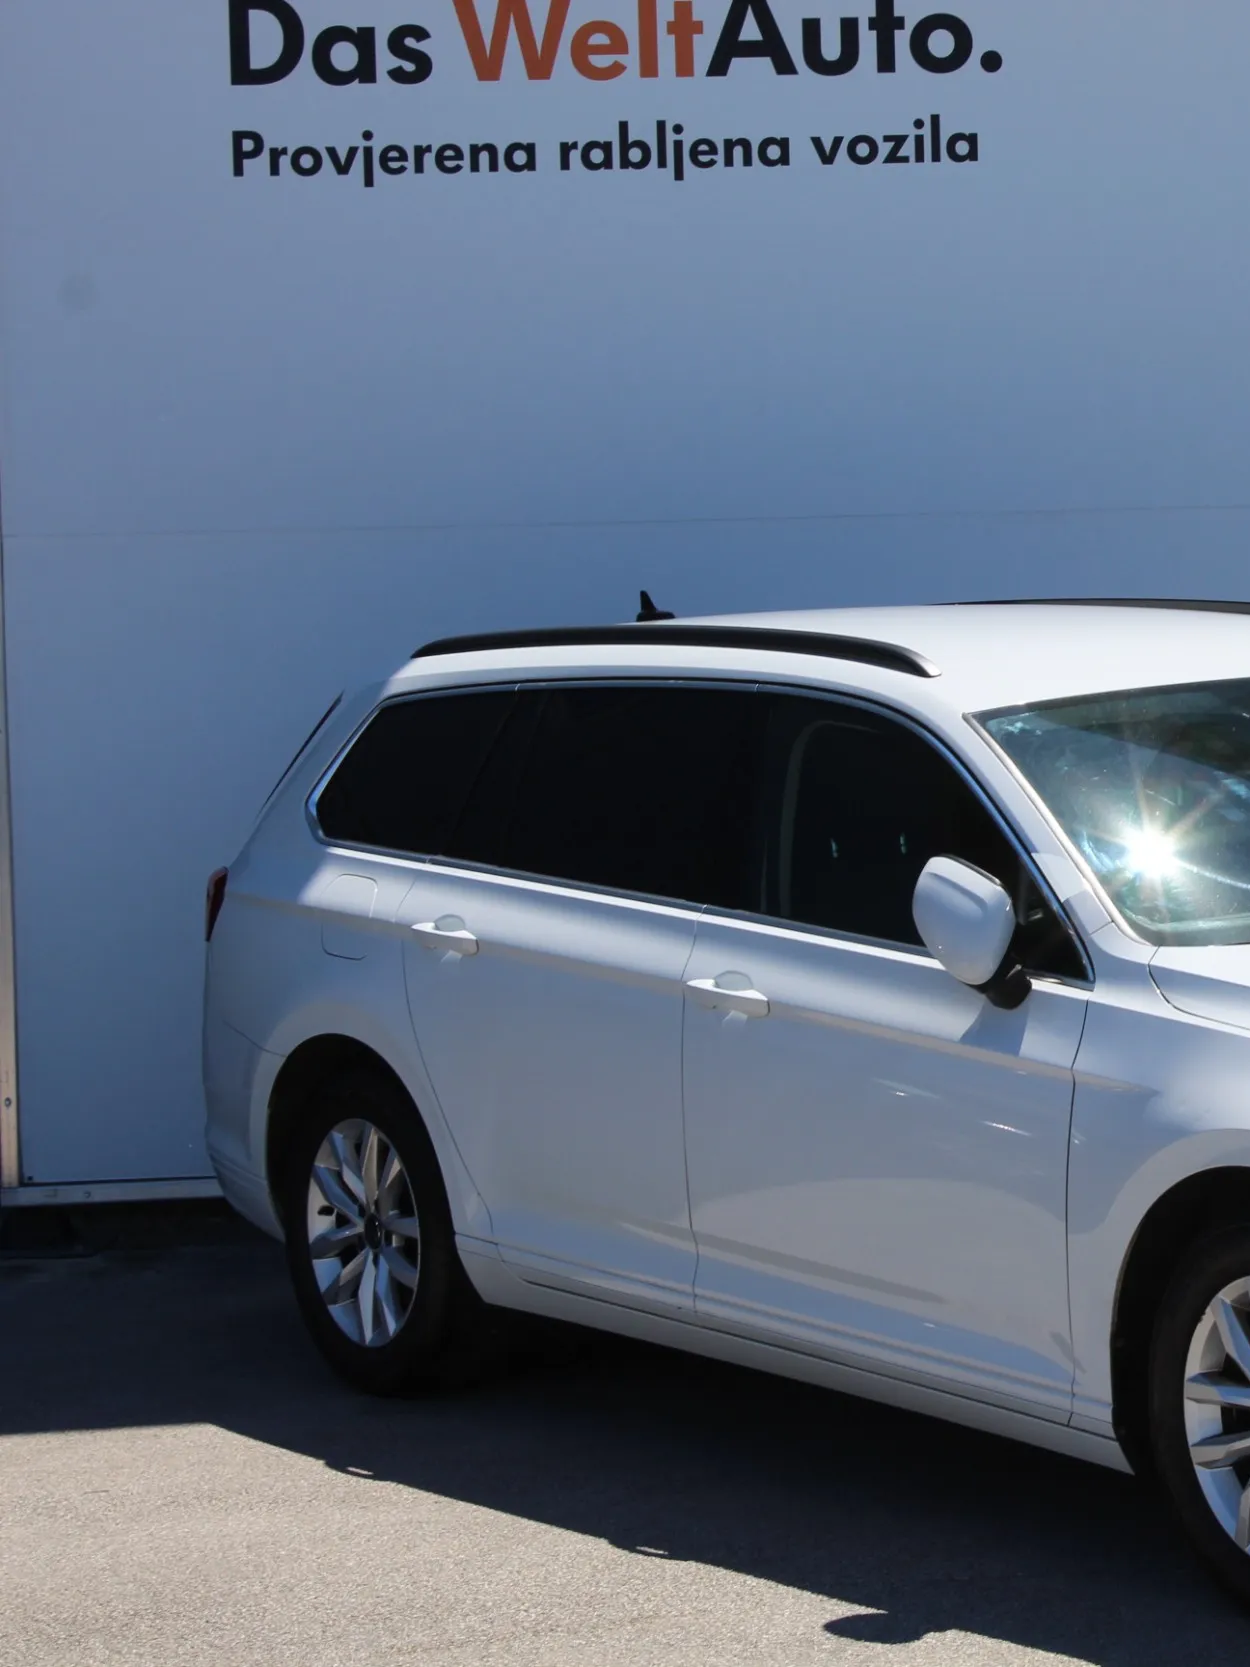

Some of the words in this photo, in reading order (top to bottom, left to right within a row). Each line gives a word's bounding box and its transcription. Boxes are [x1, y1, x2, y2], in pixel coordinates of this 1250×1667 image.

[229, 0, 433, 87] Das
[453, 0, 1003, 81] WeltAuto.
[231, 130, 537, 188] Provjerena
[559, 120, 791, 182] rabljena
[809, 114, 979, 166] vozila
